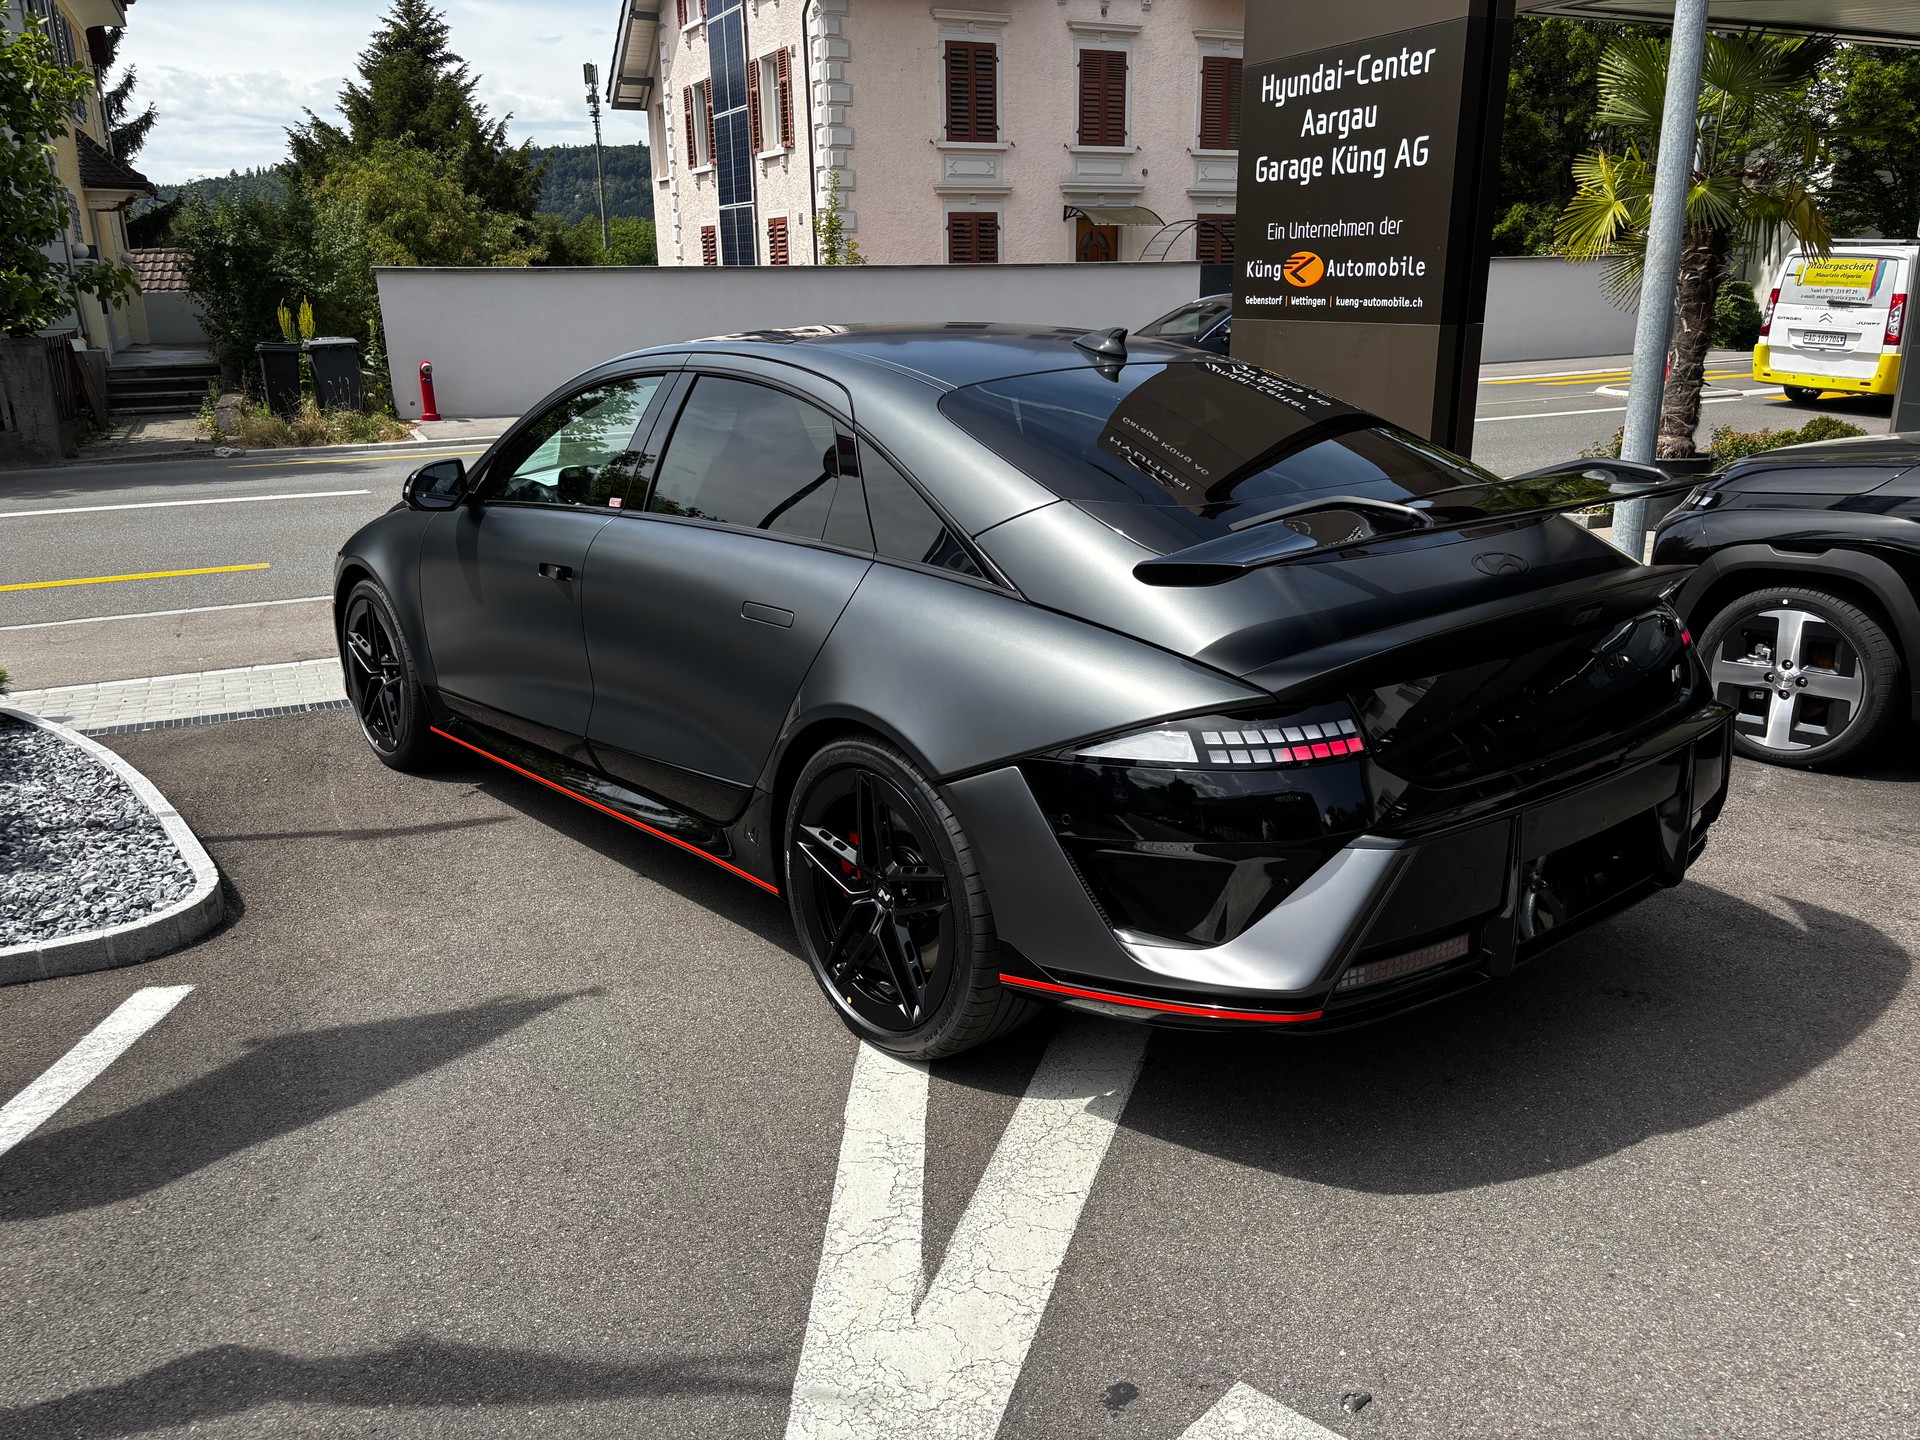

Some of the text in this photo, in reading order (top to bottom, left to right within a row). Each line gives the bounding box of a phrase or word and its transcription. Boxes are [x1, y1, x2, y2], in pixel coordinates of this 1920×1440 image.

[1261, 46, 1437, 107] Hyundai-Center
[1300, 104, 1378, 140] Aargau
[1255, 135, 1430, 186] Garage Küng AG
[1267, 215, 1404, 241] Ein Unternehmen der
[1246, 255, 1427, 281] Küng Automobile
[1807, 261, 1875, 272] Malergeschäft
[1245, 295, 1423, 308] Gebenstorf Wettingen kueng-automobile.ch
